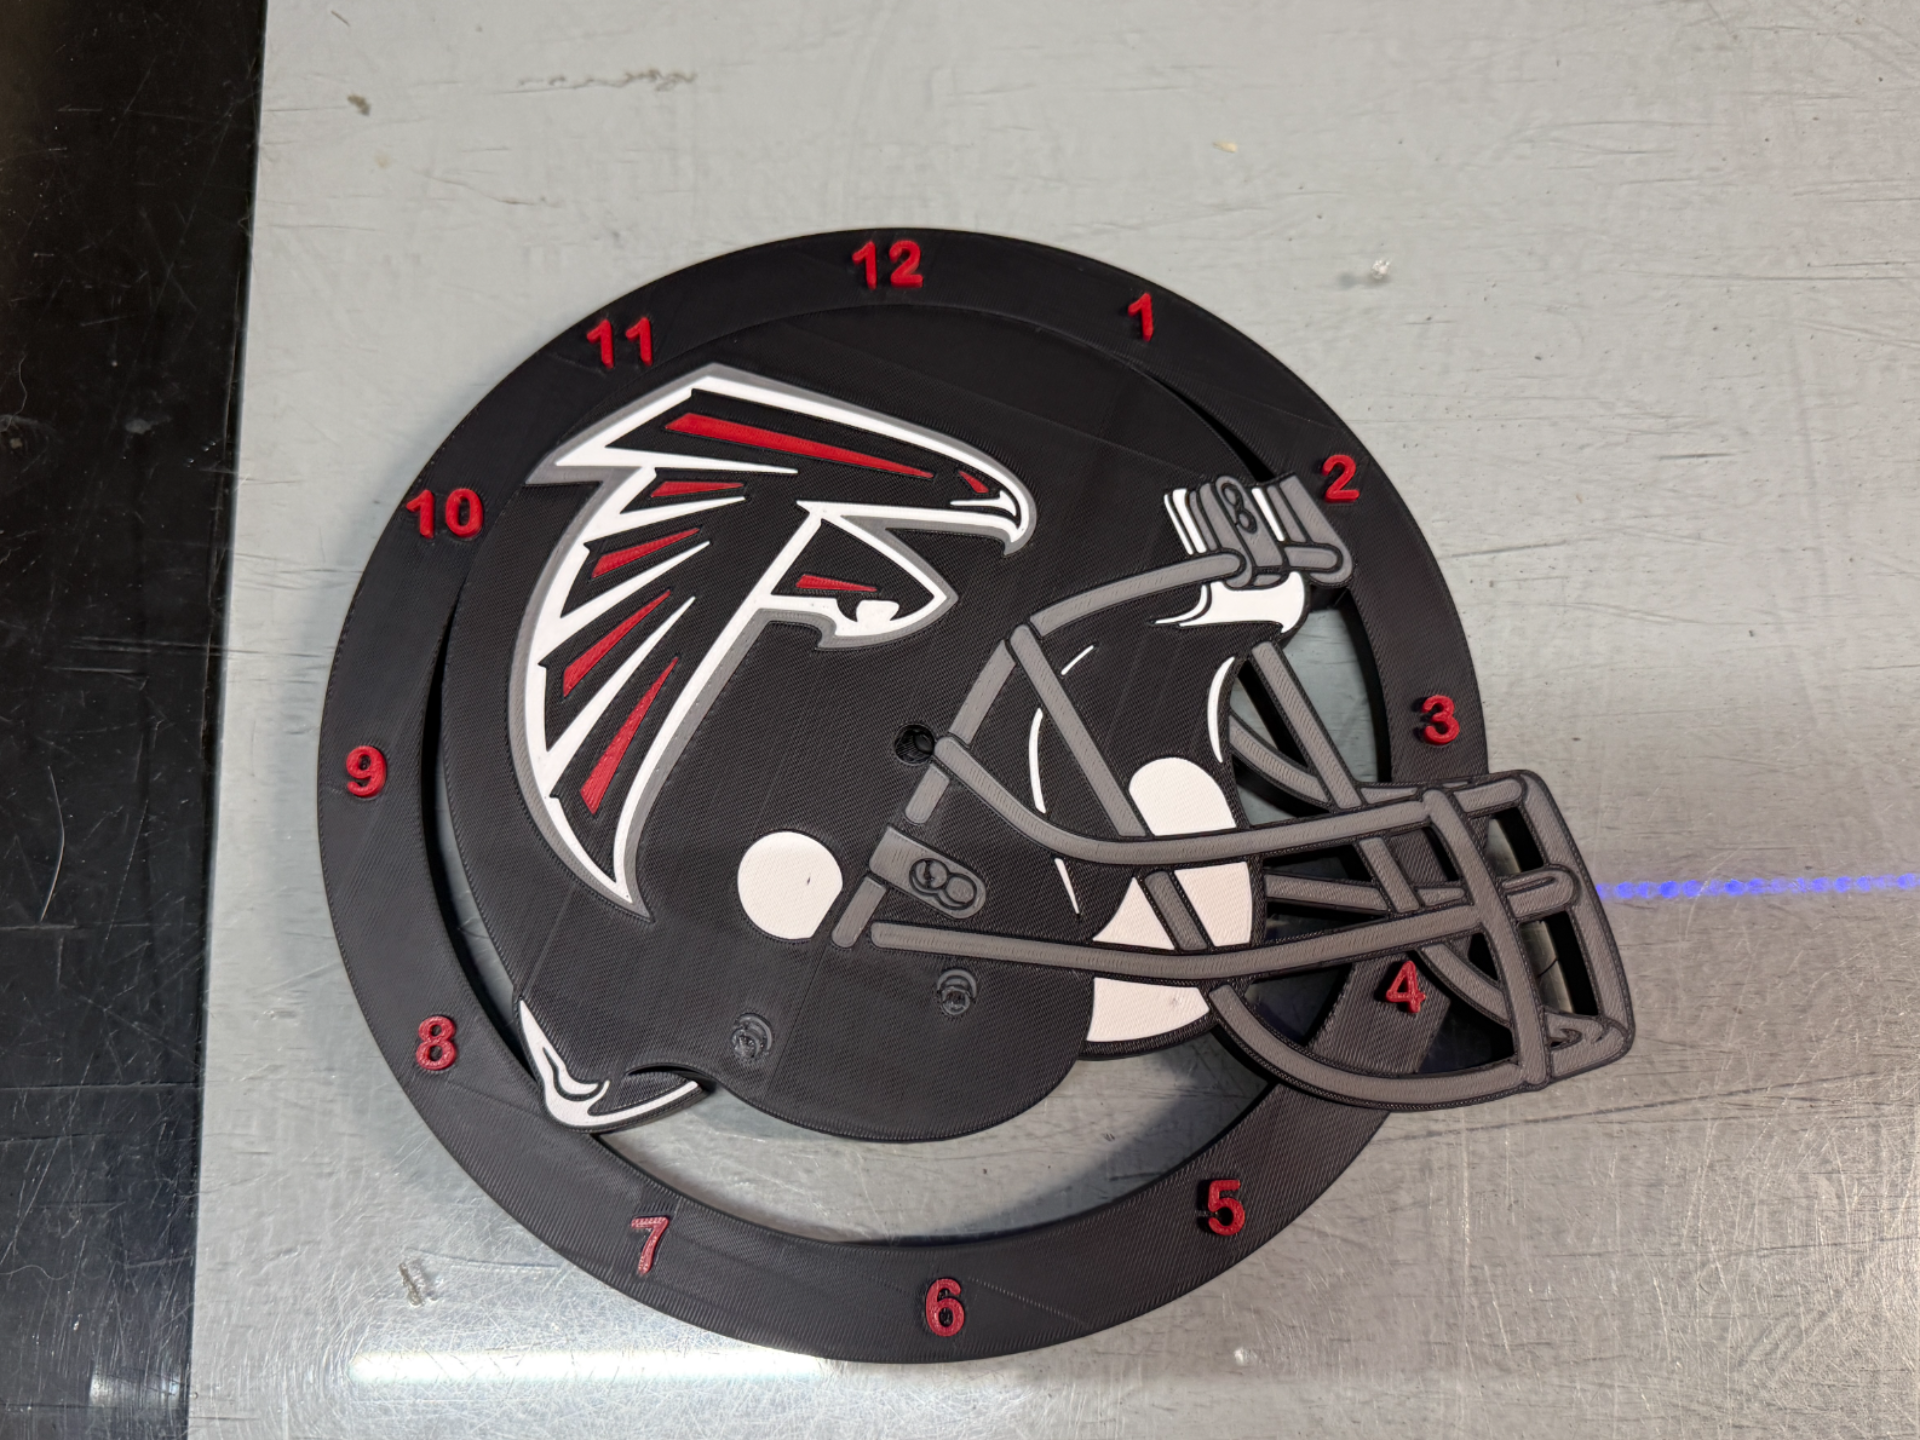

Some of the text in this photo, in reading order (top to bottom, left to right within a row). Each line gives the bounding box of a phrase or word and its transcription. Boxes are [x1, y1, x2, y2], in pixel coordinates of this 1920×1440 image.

[851, 238, 924, 290] 12
[586, 316, 654, 369] 11
[1126, 291, 1154, 342] 1
[1321, 453, 1361, 503] 2
[405, 487, 485, 540] 10
[1420, 694, 1461, 745] 3
[345, 745, 387, 799] 9
[1384, 959, 1427, 1014] 4
[415, 1015, 457, 1071] 8
[1206, 1179, 1246, 1237] 5
[630, 1215, 670, 1275] 7
[925, 1277, 965, 1338] 6
